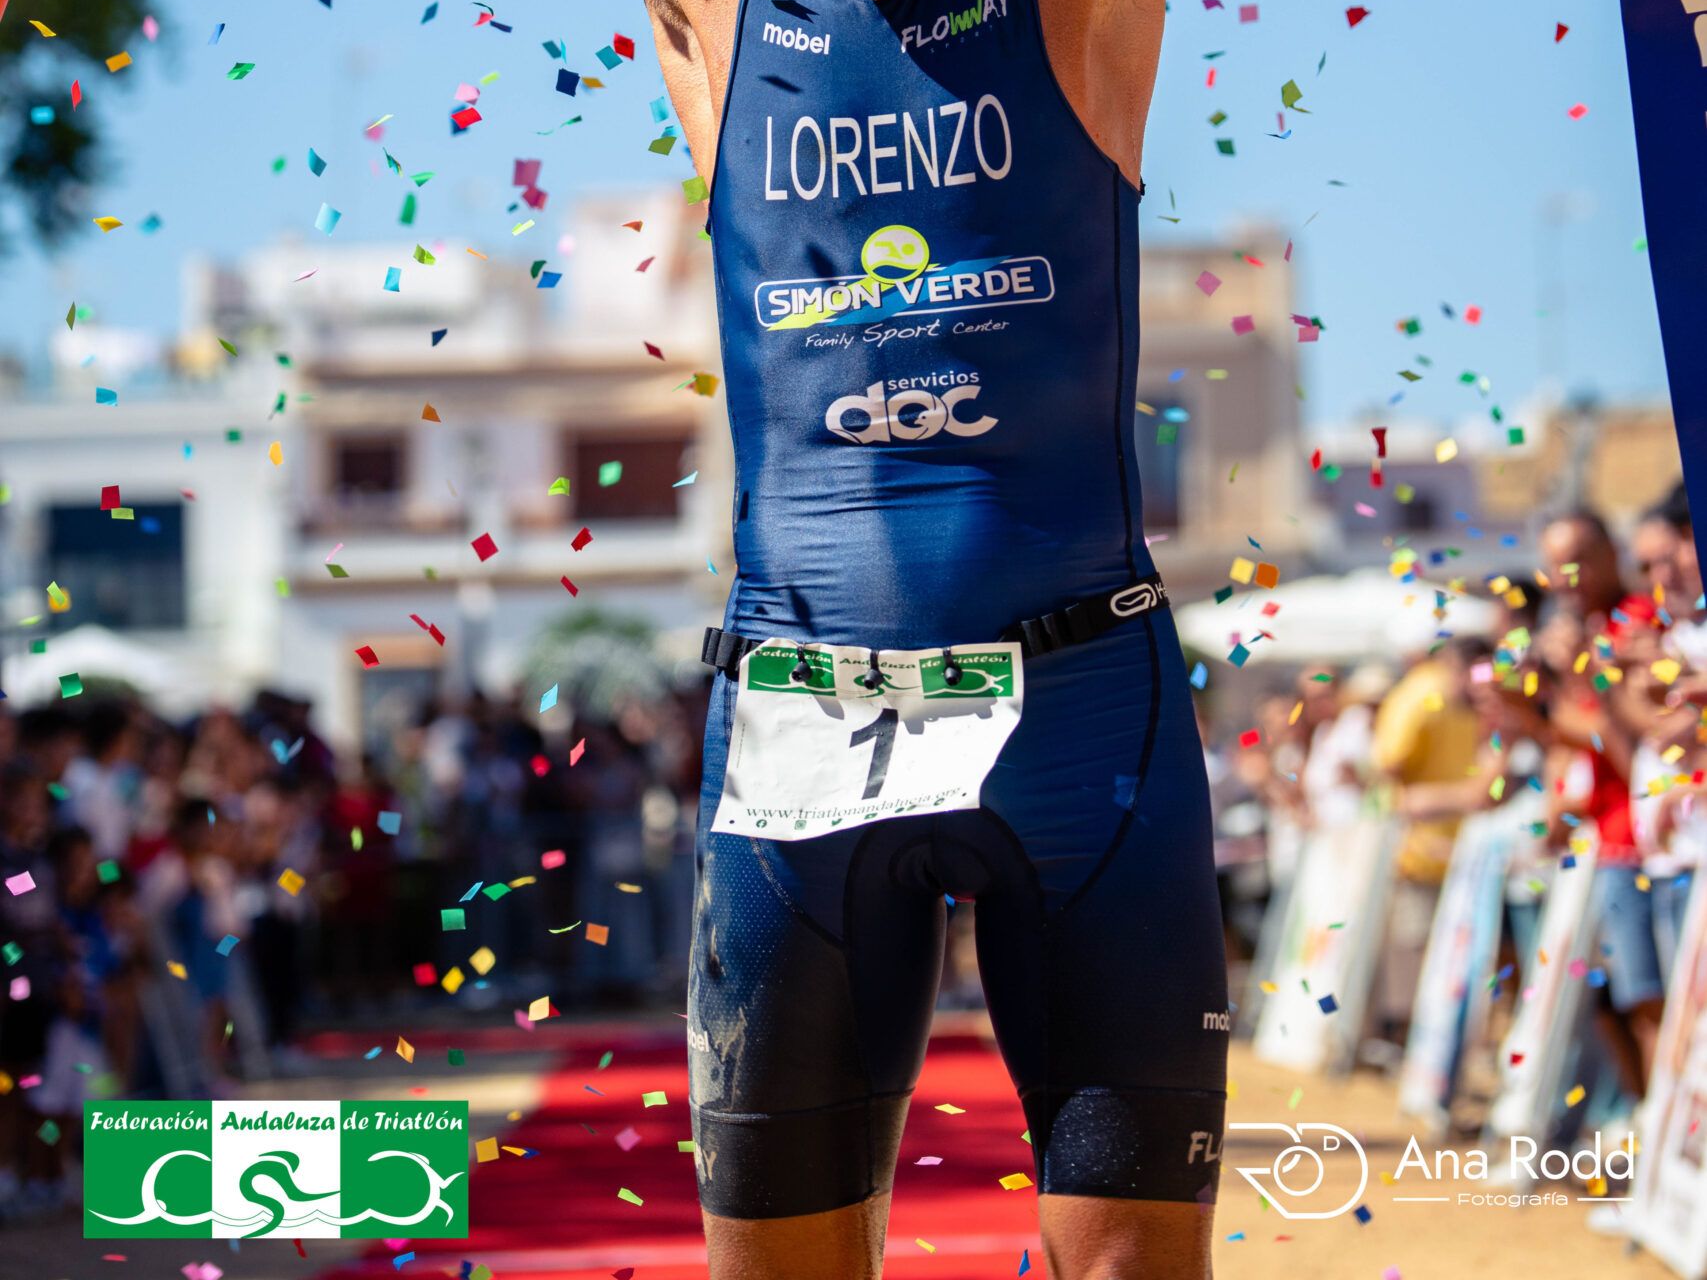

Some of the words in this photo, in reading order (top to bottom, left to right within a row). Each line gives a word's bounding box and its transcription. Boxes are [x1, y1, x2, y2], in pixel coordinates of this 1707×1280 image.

[762, 22, 831, 55] mobel
[765, 93, 1013, 201] LORENZO
[767, 280, 883, 317] SIMÓN
[895, 265, 1036, 305] VERDE
[804, 332, 854, 348] Family
[862, 318, 941, 348] Sport
[952, 319, 1011, 336] Center
[887, 370, 980, 391] servicios
[849, 708, 899, 801] 1
